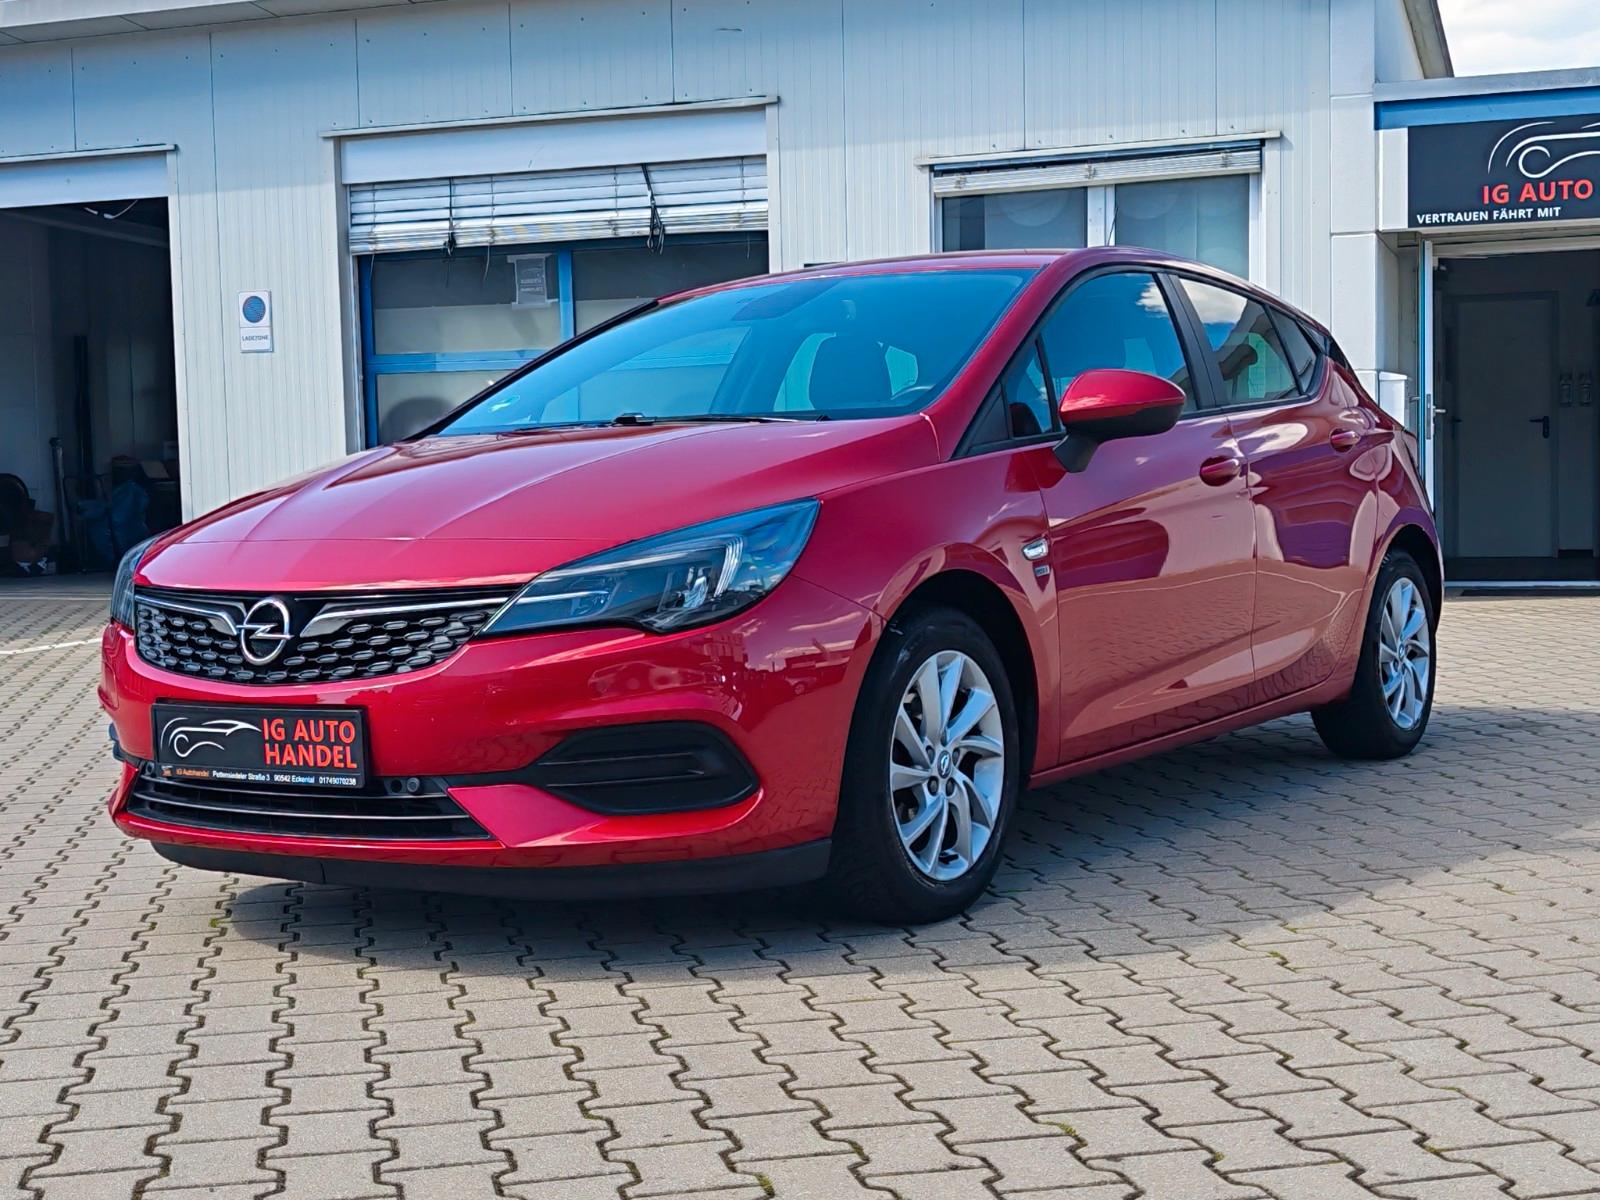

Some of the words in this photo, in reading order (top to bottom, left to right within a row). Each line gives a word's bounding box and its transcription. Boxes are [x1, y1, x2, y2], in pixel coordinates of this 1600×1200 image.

[1482, 183, 1510, 205] IG
[1519, 179, 1594, 202] AUTO
[1416, 210, 1489, 224] VERTRAUEN
[1493, 208, 1534, 220] FÄHRT
[1537, 206, 1562, 218] MIT
[263, 718, 286, 741] IG
[294, 719, 356, 744] AUTO
[264, 743, 358, 769] HANDEL
